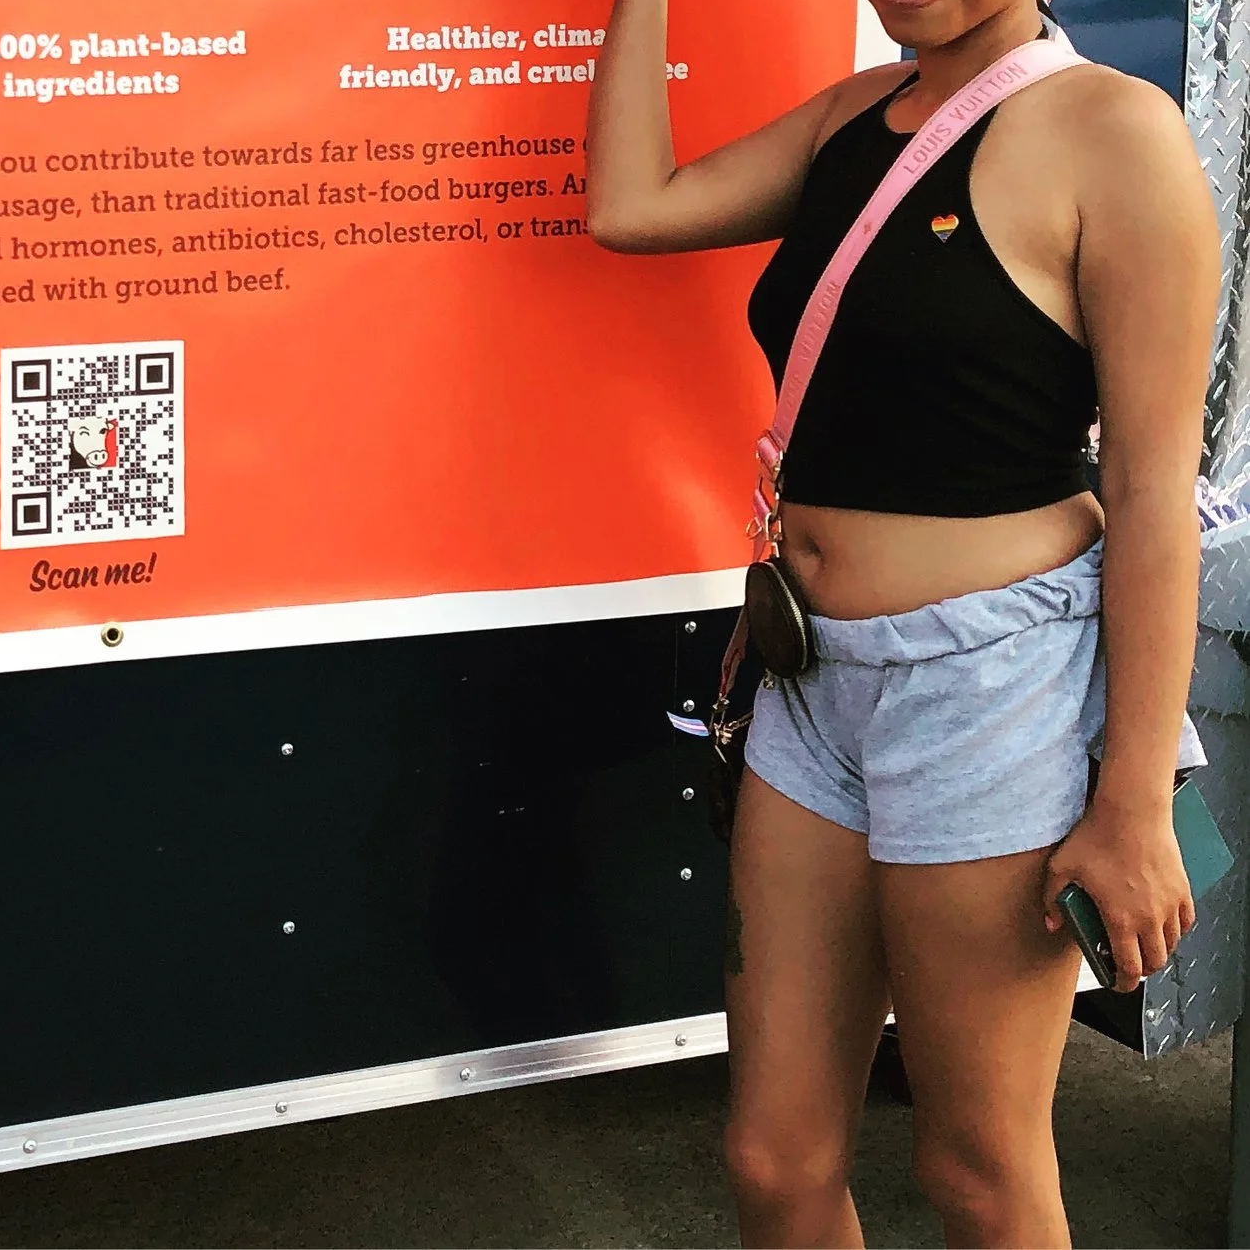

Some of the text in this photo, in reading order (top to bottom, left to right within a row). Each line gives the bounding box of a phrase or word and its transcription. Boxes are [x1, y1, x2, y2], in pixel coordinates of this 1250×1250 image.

[69, 29, 247, 65] plant-based
[387, 23, 606, 51] Healthier, clima
[2, 69, 180, 104] ingredients
[339, 62, 462, 93] friendly,
[468, 60, 521, 86] and
[902, 61, 1029, 176] LOUIS VUITTON
[45, 146, 196, 173] contribute
[201, 141, 313, 167] towards
[319, 139, 359, 163] far
[364, 138, 415, 162] less
[422, 134, 576, 166] greenhouse
[90, 190, 157, 215] than
[163, 182, 311, 211] traditional
[317, 177, 441, 205] fast-food
[447, 177, 554, 204] burgers.
[10, 236, 164, 260] hormones,
[171, 224, 326, 254] antibiotics,
[333, 217, 488, 246] cholesterol,
[496, 221, 525, 240] or
[42, 275, 108, 302] with
[115, 270, 219, 304] ground
[225, 266, 291, 293] beef.
[29, 551, 158, 593] Scan me!
